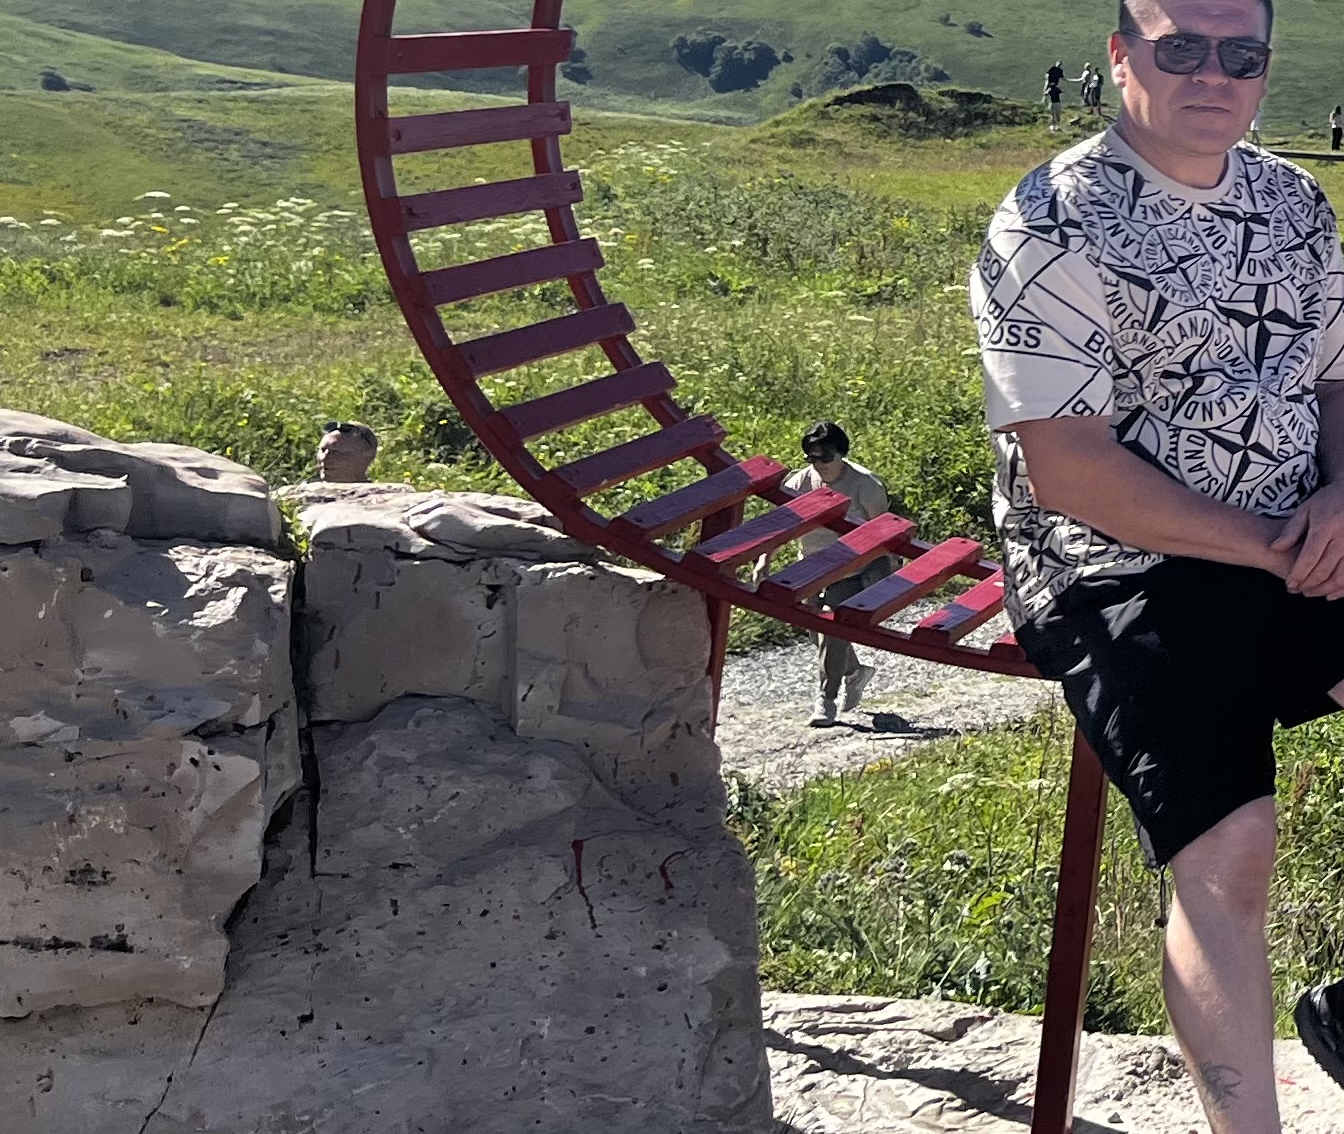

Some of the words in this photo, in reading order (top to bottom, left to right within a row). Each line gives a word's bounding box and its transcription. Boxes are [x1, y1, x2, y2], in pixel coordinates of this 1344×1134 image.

[1214, 327, 1252, 375] STONE
[1184, 385, 1251, 422] ISLAND
[1184, 433, 1224, 499] ISLAND
